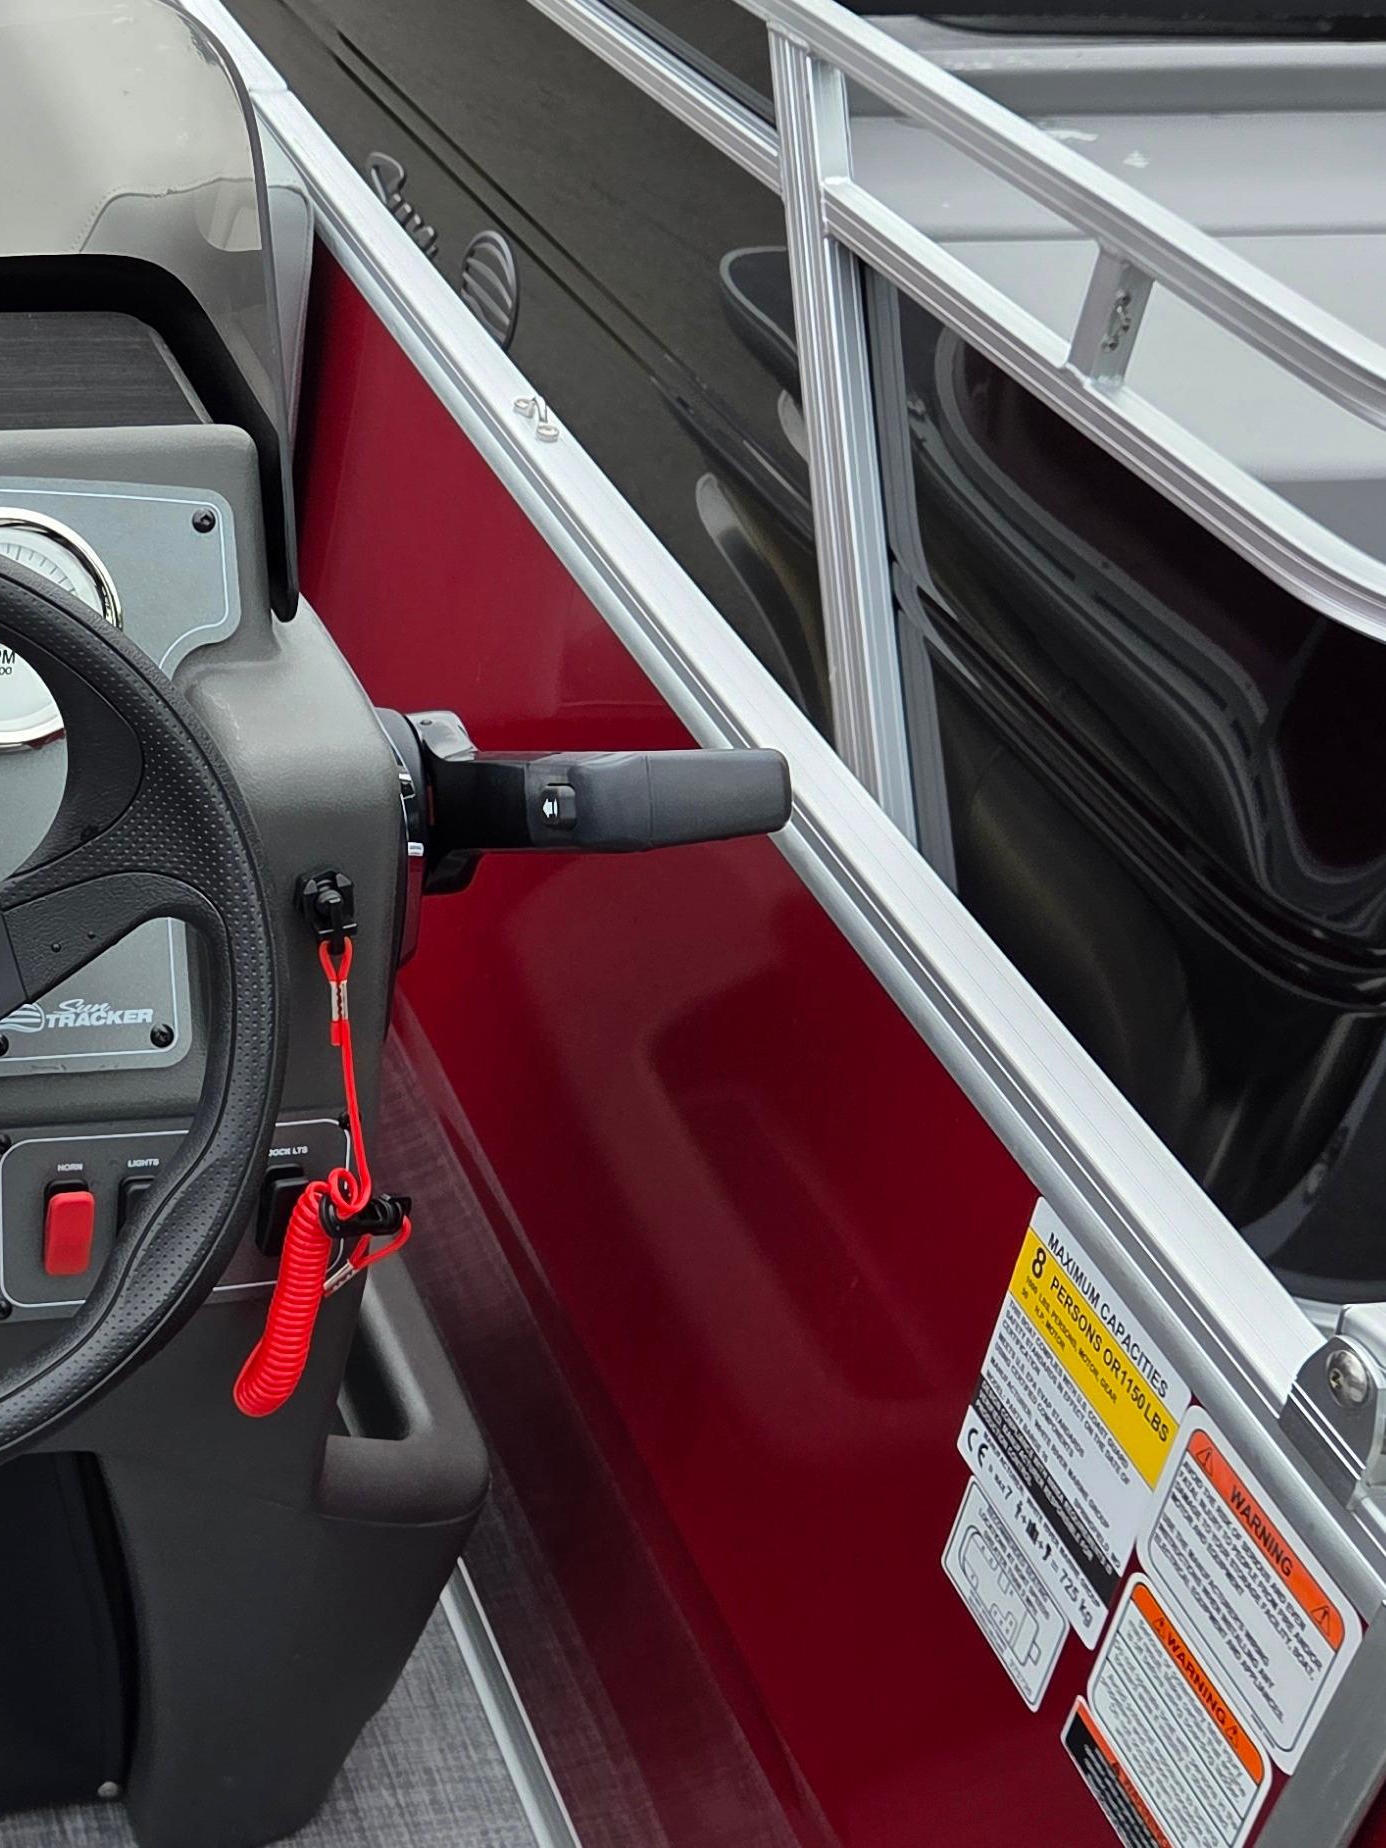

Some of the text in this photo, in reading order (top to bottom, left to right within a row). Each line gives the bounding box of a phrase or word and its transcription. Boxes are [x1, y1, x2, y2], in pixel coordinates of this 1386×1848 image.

[45, 1008, 154, 1029] TRACKER
[54, 998, 112, 1014] Sun
[57, 1163, 84, 1172] HORN
[127, 1158, 160, 1168] LIGHTS
[1045, 1319, 1066, 1351] MOTOR
[1047, 1231, 1169, 1399] MAXIMUM CAPACITIES
[1031, 1247, 1047, 1279] 8
[1049, 1274, 1103, 1354] PERSONS
[1143, 1401, 1170, 1444] LBS
[1228, 1484, 1294, 1580] WARNING
[1057, 1566, 1080, 1605] 725
[1076, 1597, 1095, 1630] kg
[1165, 1632, 1227, 1727] WARNING
